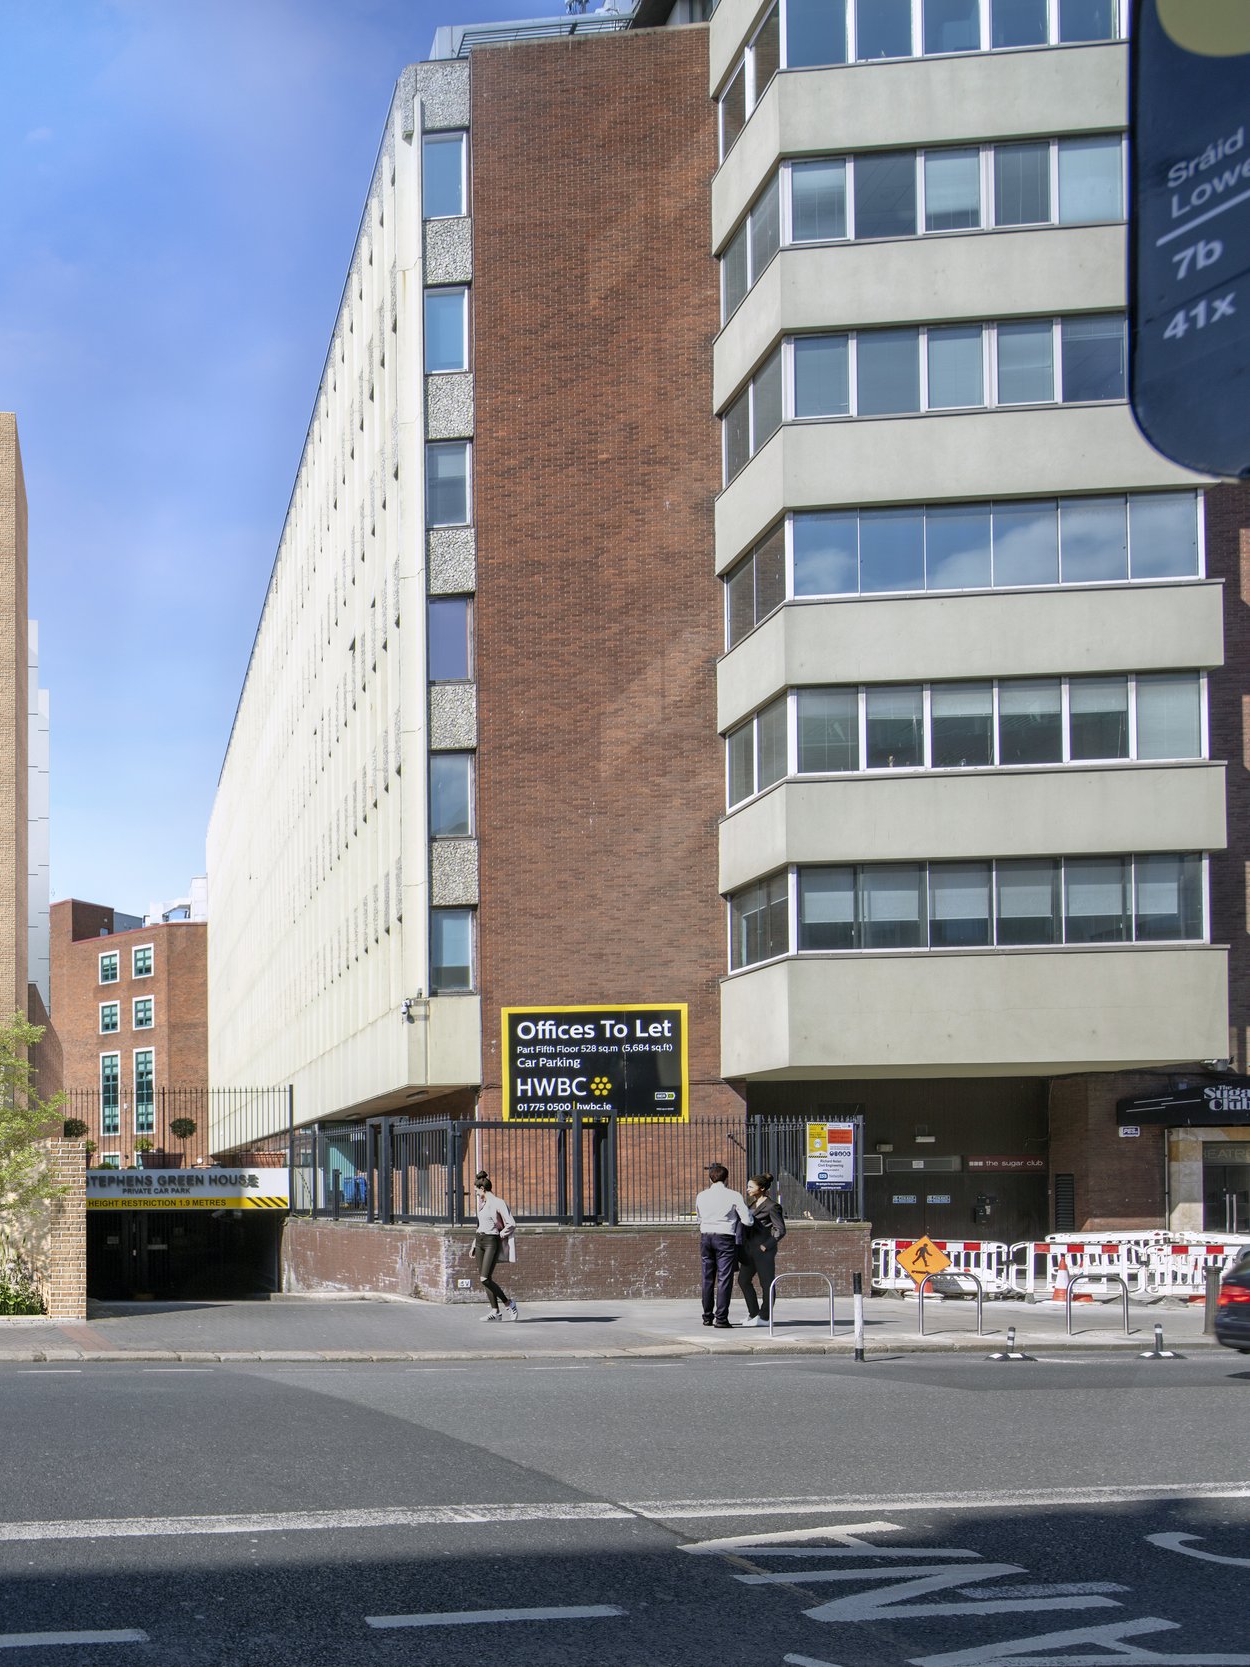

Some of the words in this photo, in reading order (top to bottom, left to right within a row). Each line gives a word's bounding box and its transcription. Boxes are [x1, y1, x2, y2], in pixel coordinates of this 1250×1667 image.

[1168, 127, 1244, 188] Sráid
[1172, 239, 1223, 280] 7b
[1163, 291, 1236, 339] 41x
[516, 1020, 596, 1039] Offices
[600, 1020, 628, 1038] To
[635, 1019, 672, 1037] Let
[536, 1045, 555, 1053] Fifth
[556, 1045, 579, 1053] Floor
[580, 1044, 597, 1052] 528
[598, 1045, 618, 1053] sq.m
[621, 1043, 649, 1052] (5,684
[651, 1043, 673, 1052] sq.ft)
[517, 1057, 536, 1067] Car
[539, 1057, 581, 1068] Parking
[516, 1077, 587, 1097] HWBC
[530, 1103, 545, 1111] 775
[547, 1103, 571, 1111] 0500
[576, 1102, 612, 1110] hwbc.ie
[1001, 1160, 1023, 1168] sugar
[157, 1174, 204, 1187] GREEN
[209, 1174, 260, 1188] HOUSE
[121, 1199, 177, 1207] RESTRICTION
